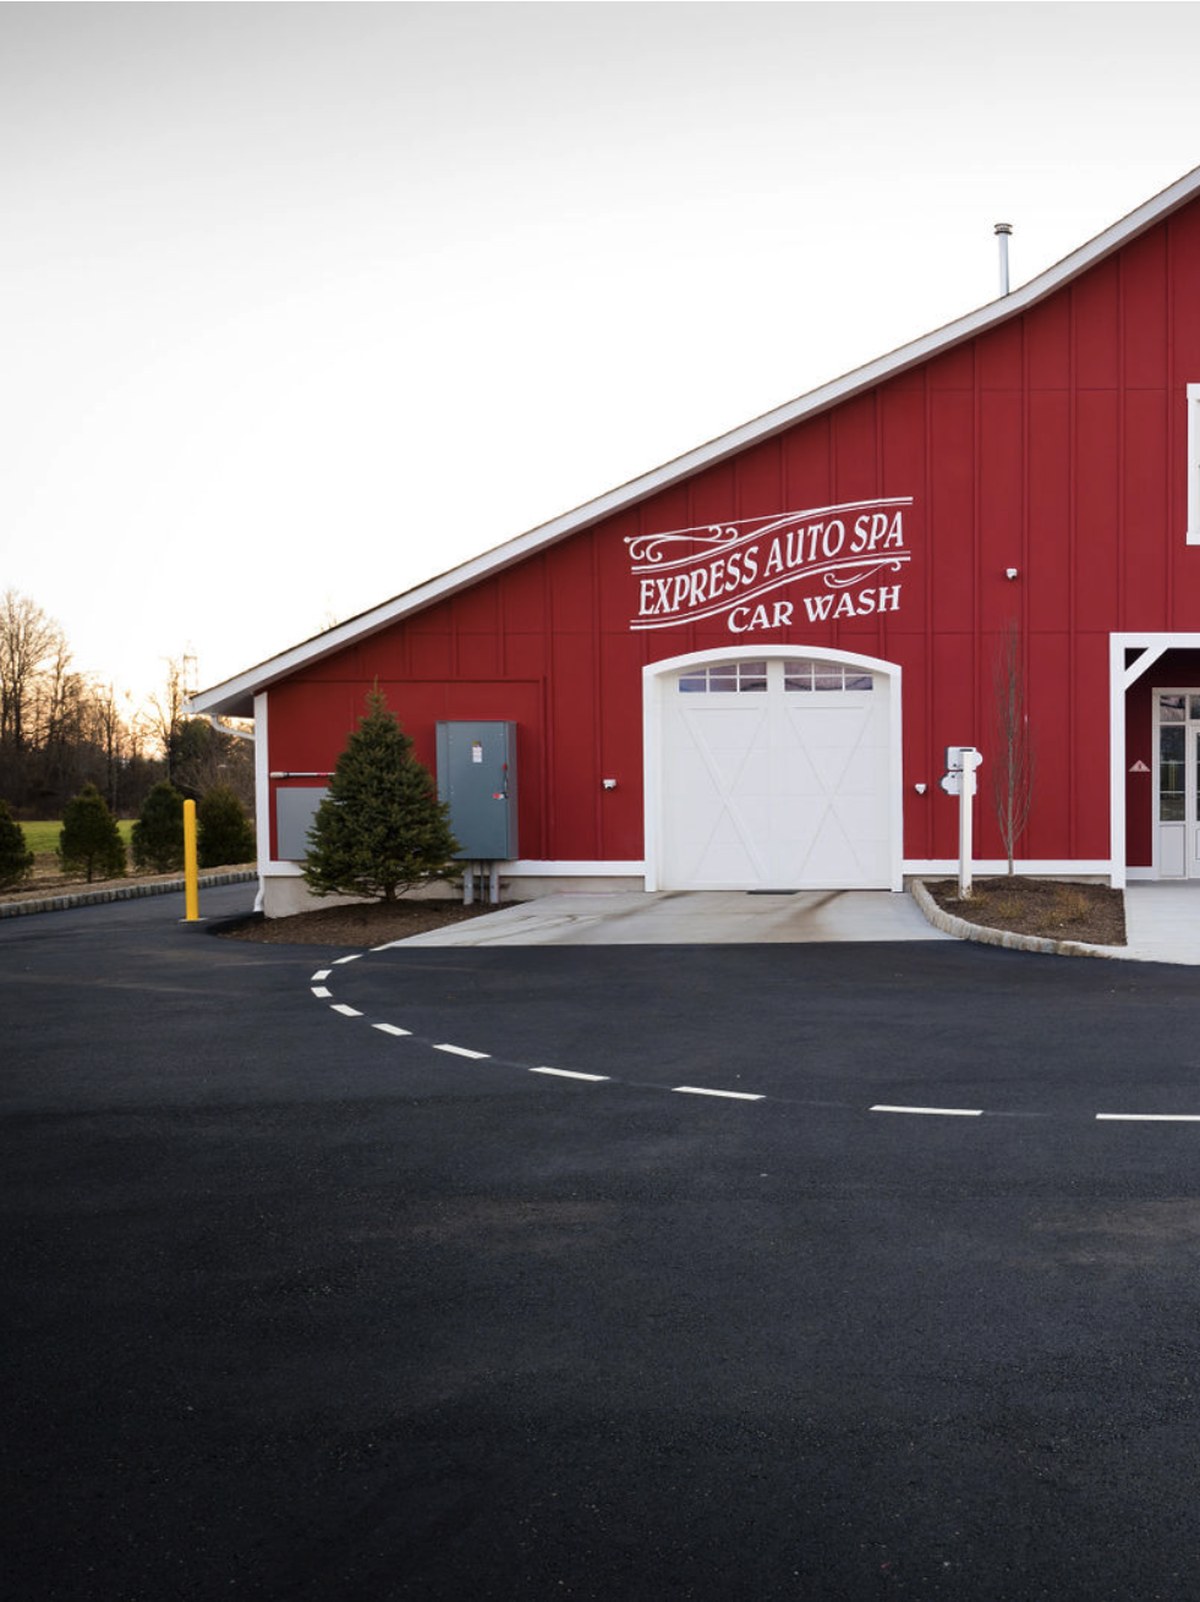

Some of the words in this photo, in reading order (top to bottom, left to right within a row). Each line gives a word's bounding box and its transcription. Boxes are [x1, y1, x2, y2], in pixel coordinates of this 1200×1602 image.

[638, 546, 759, 615] EXPRESS
[764, 520, 845, 577] AUTO
[850, 511, 904, 553] SPA
[727, 601, 793, 633] CAR
[803, 585, 902, 623] WASH
